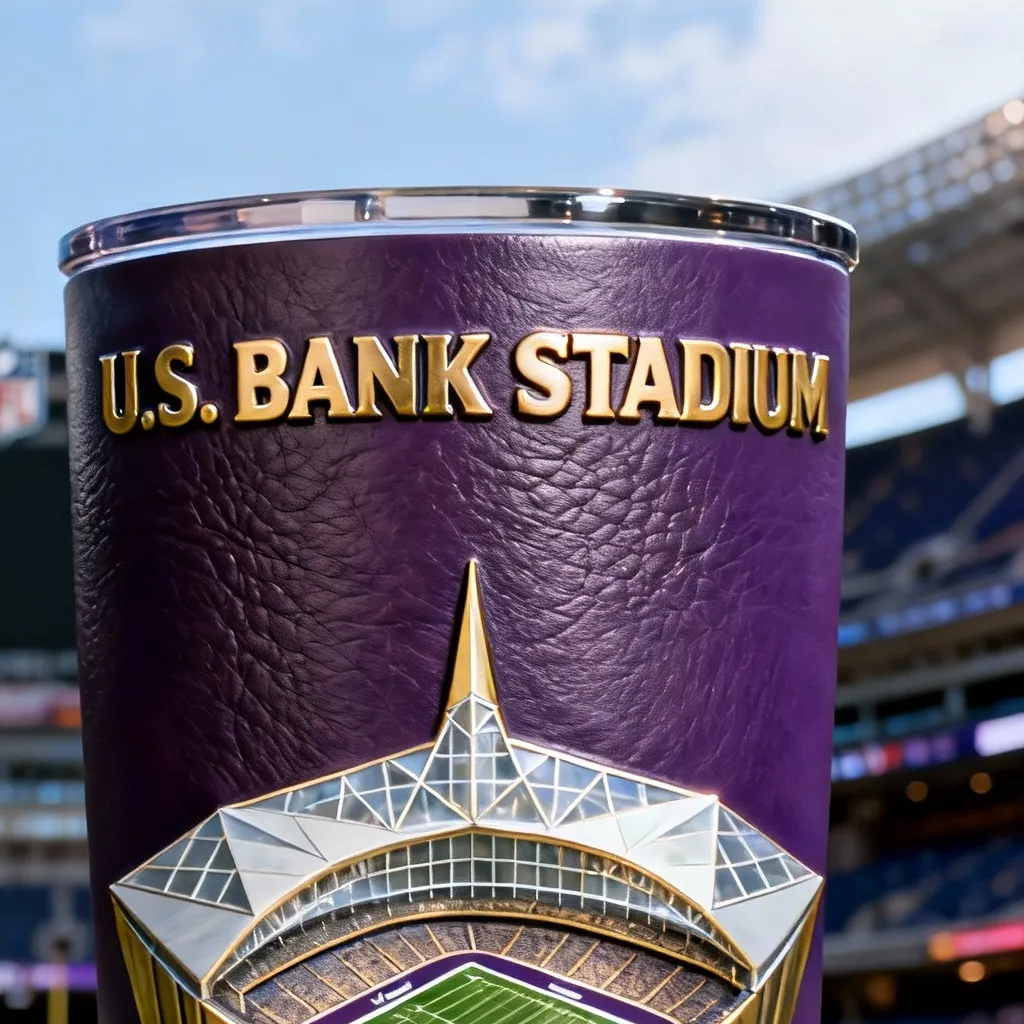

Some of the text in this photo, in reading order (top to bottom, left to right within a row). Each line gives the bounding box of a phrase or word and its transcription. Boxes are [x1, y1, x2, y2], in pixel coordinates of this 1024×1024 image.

[99, 330, 830, 438] U.S. BANK STADIUM
